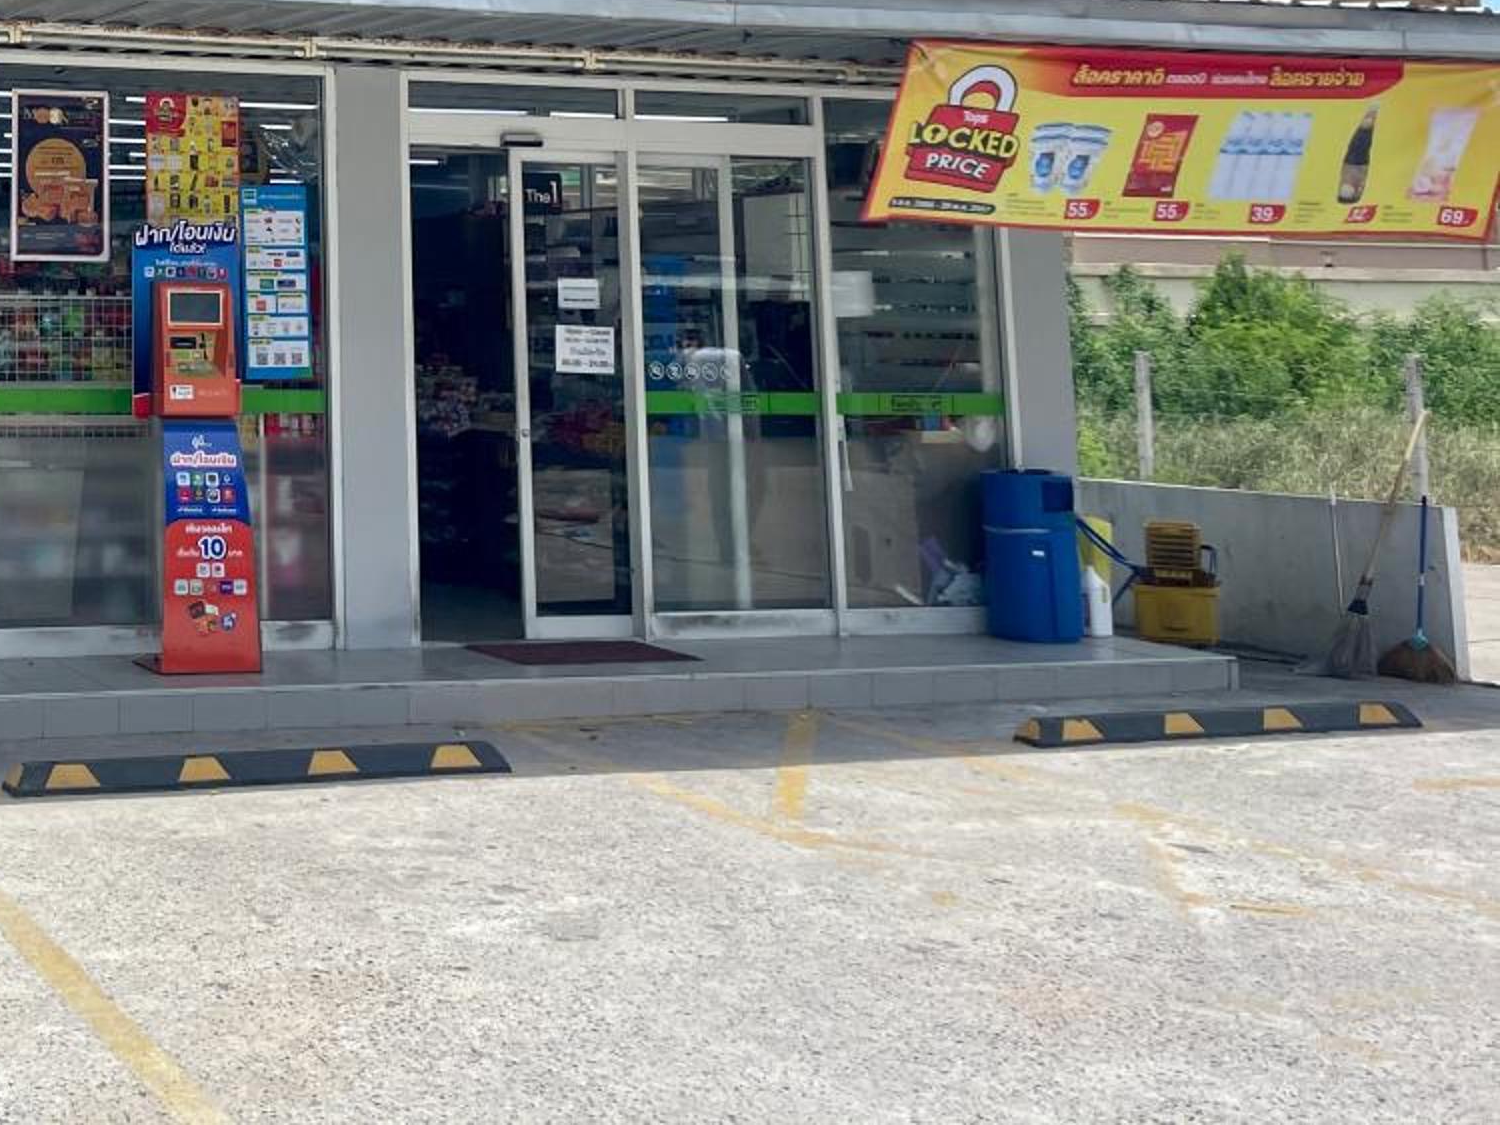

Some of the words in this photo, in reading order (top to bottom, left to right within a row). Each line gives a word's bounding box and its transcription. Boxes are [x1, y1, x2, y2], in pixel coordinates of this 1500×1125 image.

[908, 122, 1019, 159] LOCKED
[925, 152, 991, 179] PRICE
[135, 220, 236, 246] ฝาก/โอนเงิน
[198, 536, 227, 559] 10
